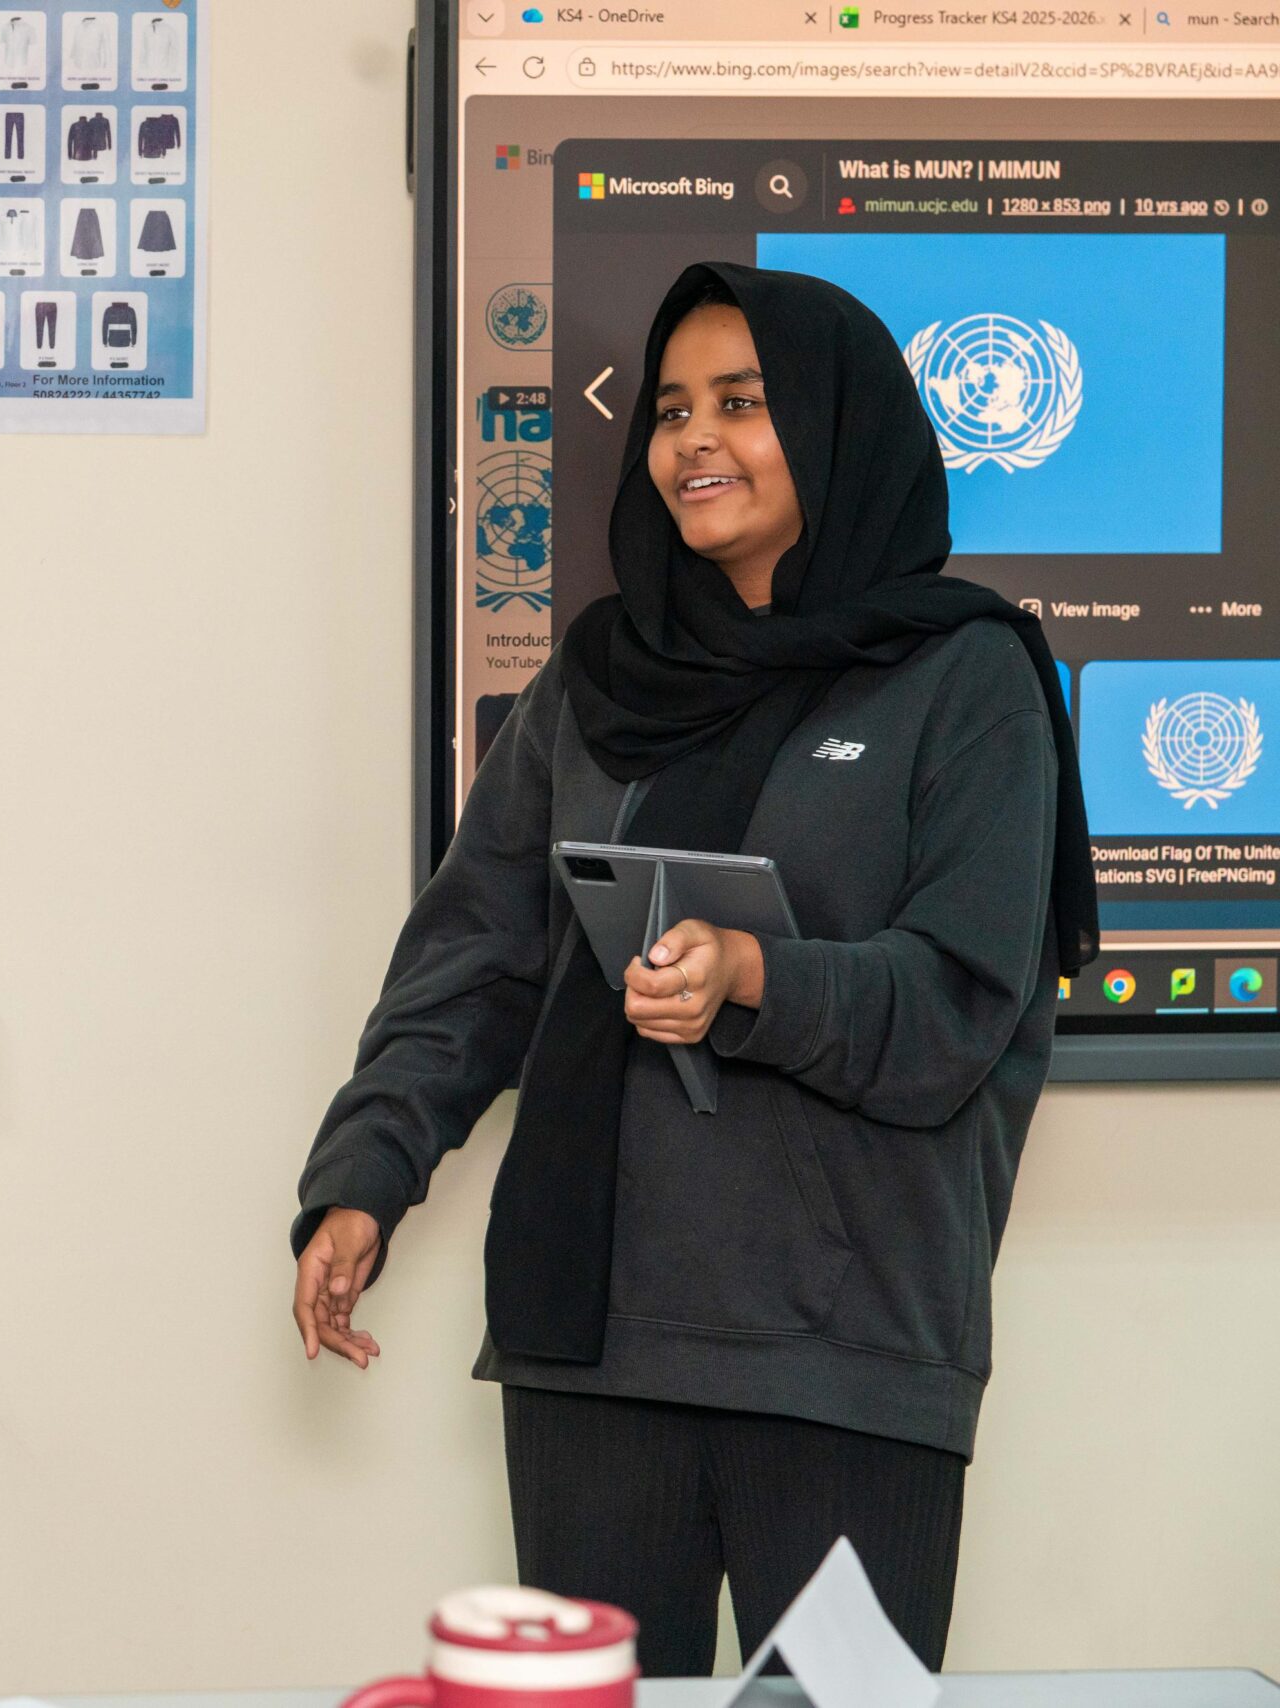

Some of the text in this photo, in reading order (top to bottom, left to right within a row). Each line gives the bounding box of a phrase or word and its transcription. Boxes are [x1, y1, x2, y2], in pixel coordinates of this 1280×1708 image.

[557, 9, 583, 23] KS4
[598, 9, 665, 24] OneDrive
[873, 10, 934, 26] Progress
[938, 10, 989, 25] Tracker
[992, 11, 1017, 25] KS4
[1187, 14, 1219, 26] mun
[1233, 11, 1279, 26] Search
[611, 61, 1280, 81] https://www.bing.com/images/search?view=detailV2&ccid=SP%2BVRAEj&id=AA9
[839, 160, 889, 179] What
[893, 160, 911, 179] is
[914, 160, 973, 179] MUN?
[988, 160, 1061, 179] MIMUN
[609, 177, 734, 200] Microsoft Bing
[864, 197, 979, 215] mimun.ucjc.edu
[1001, 198, 1038, 214] 1280
[1053, 198, 1082, 214] 853
[1083, 200, 1112, 216] png
[1134, 198, 1154, 214] 10
[1156, 201, 1180, 216] yrs
[1180, 201, 1209, 216] ago
[33, 374, 165, 387] For More Information
[516, 392, 546, 405] 2:48
[1051, 602, 1141, 621] View image
[1222, 602, 1263, 617] More
[486, 632, 552, 648] Introduc
[486, 656, 543, 669] YouTube
[1090, 844, 1280, 864] Download Flag Of The Unite
[1145, 867, 1177, 884] SVG
[1186, 867, 1276, 885] FreePNGimg
